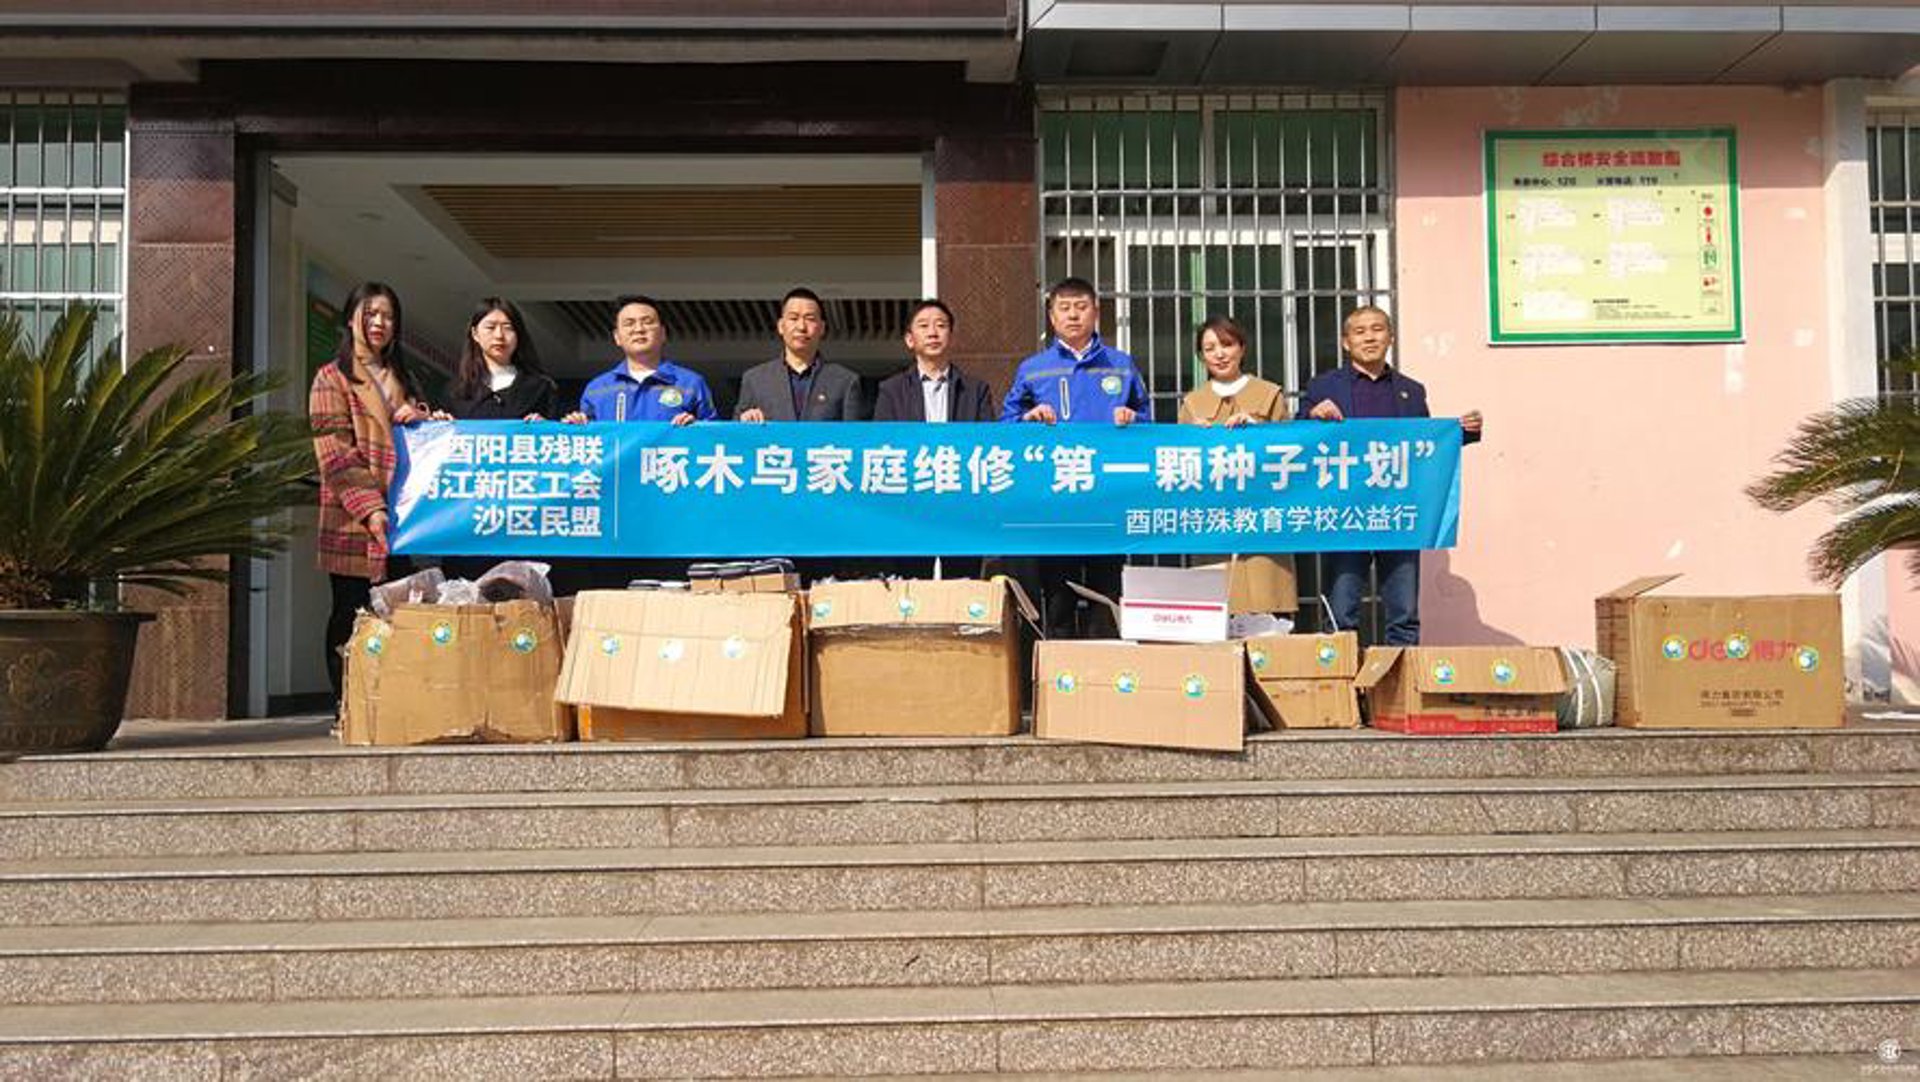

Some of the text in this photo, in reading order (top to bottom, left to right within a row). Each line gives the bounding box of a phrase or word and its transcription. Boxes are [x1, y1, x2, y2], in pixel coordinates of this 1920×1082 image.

[444, 434, 602, 464] 酉阳县残联
[473, 505, 602, 536] 沙区民盟
[1125, 505, 1418, 535] 酉阳特殊教育学校公益行
